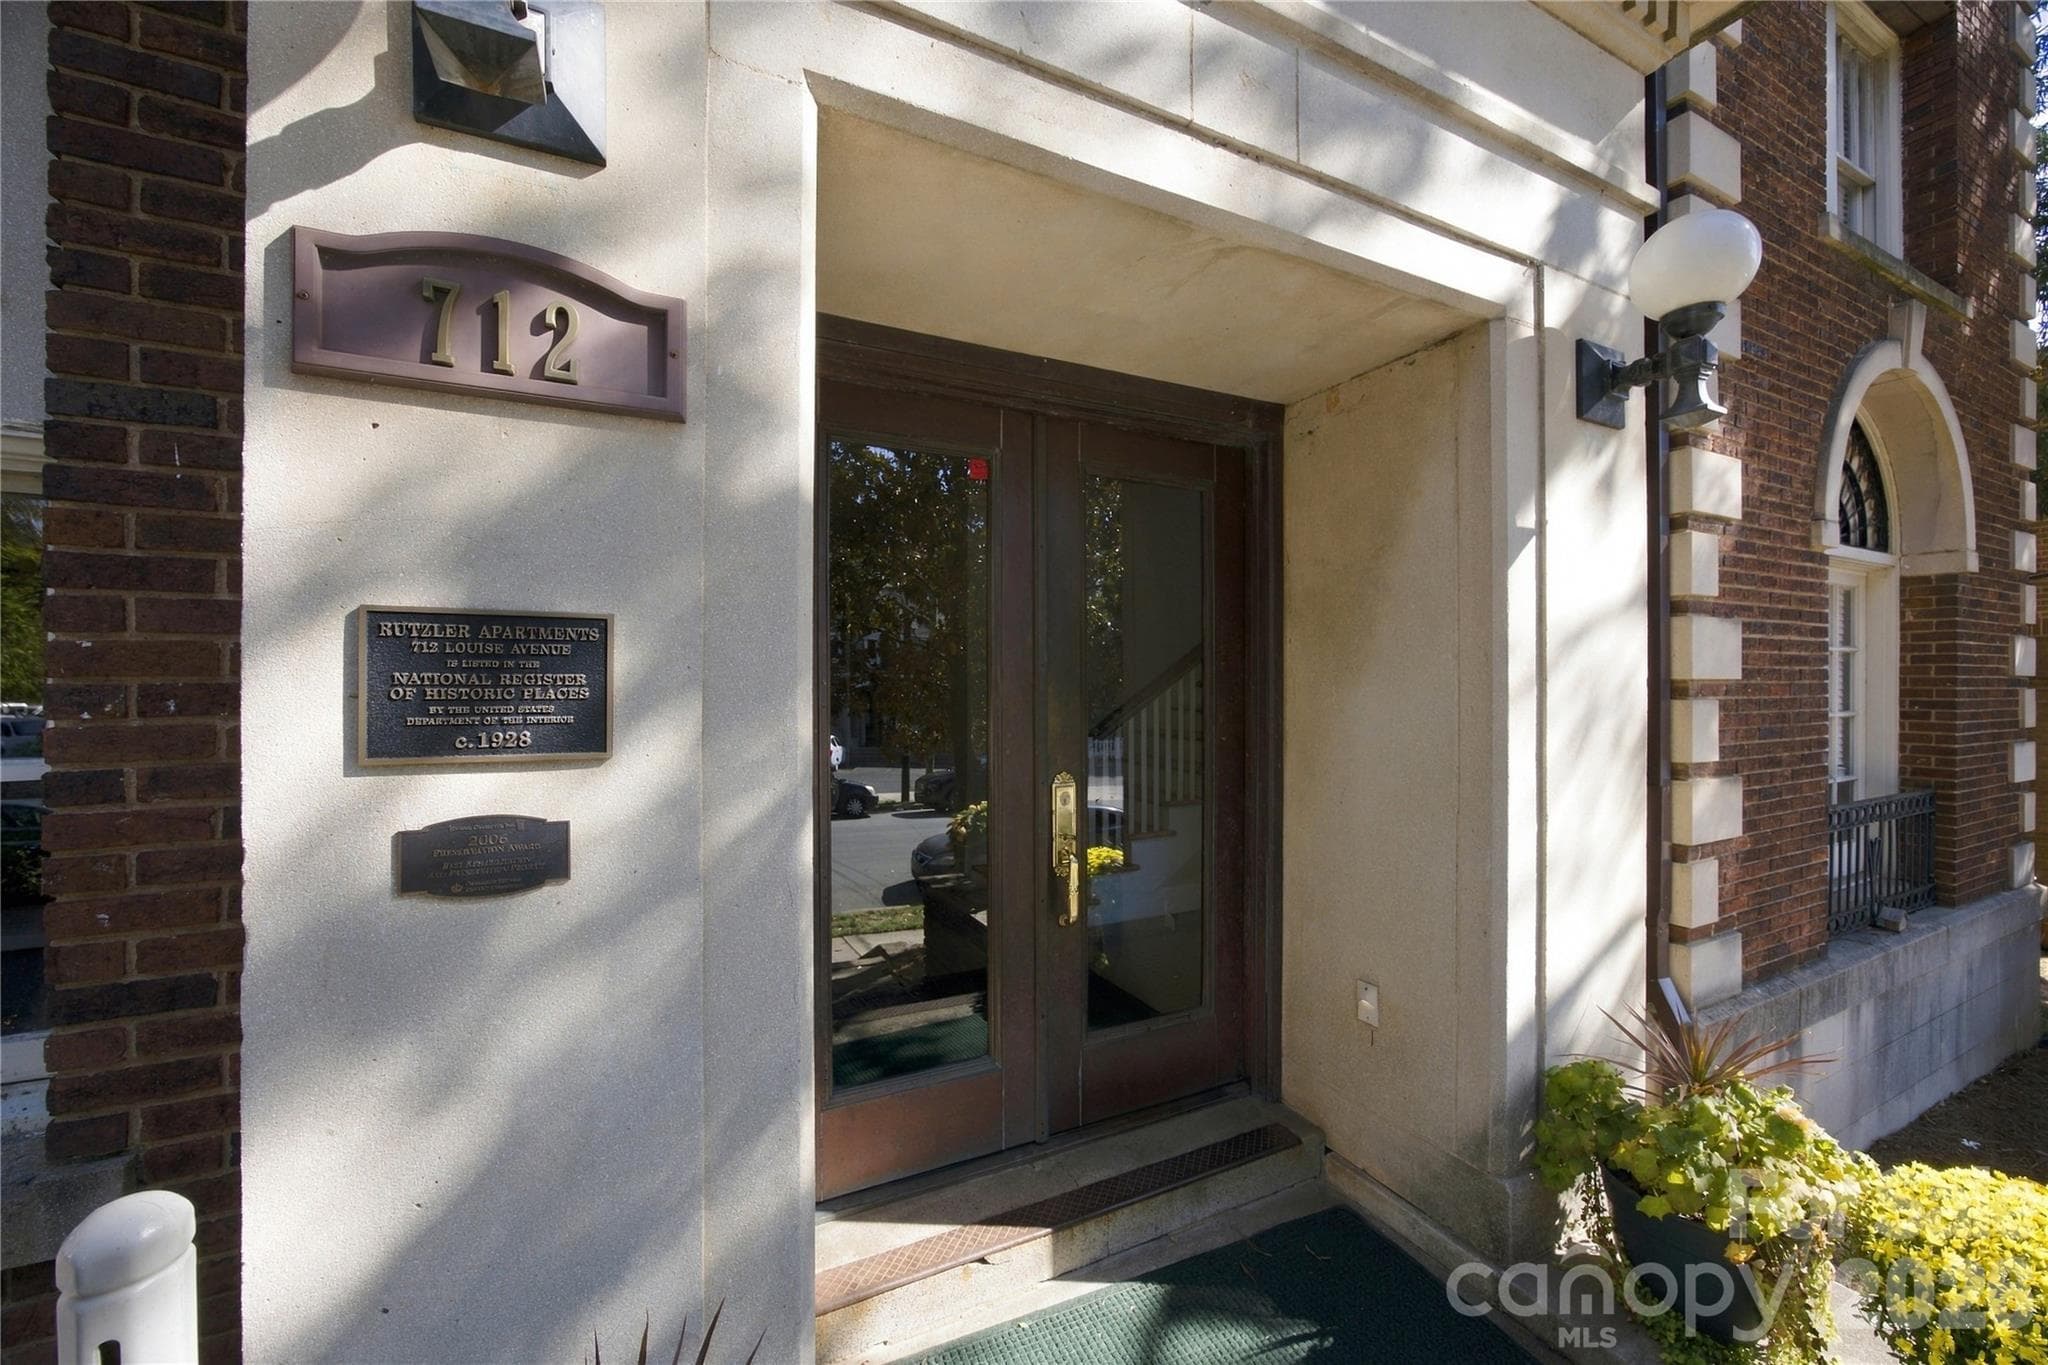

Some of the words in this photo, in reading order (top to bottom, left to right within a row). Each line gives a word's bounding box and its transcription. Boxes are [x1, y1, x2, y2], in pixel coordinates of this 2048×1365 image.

[422, 277, 581, 385] 712
[379, 621, 471, 639] RUTZLER
[478, 624, 600, 642] APARTMENTS
[411, 640, 439, 654] 712
[445, 641, 505, 655] LOUISE
[511, 643, 572, 656] AVENUE
[446, 659, 459, 668] IS
[462, 659, 500, 669] LISTED
[503, 660, 515, 669] IN
[519, 660, 541, 669] THE
[392, 671, 492, 686] NATIONAL
[500, 673, 588, 686] REGISTER
[390, 687, 417, 700] OF
[424, 687, 516, 700] HISTORIC
[523, 686, 590, 700] PLACES
[428, 705, 445, 714] BY
[448, 705, 470, 714] THE
[474, 704, 515, 714] UNITED
[518, 704, 555, 714] STATES
[406, 716, 481, 726] DEPARTMENT
[483, 715, 498, 725] OF
[501, 715, 523, 725] THE
[526, 714, 575, 725] INTERIOR
